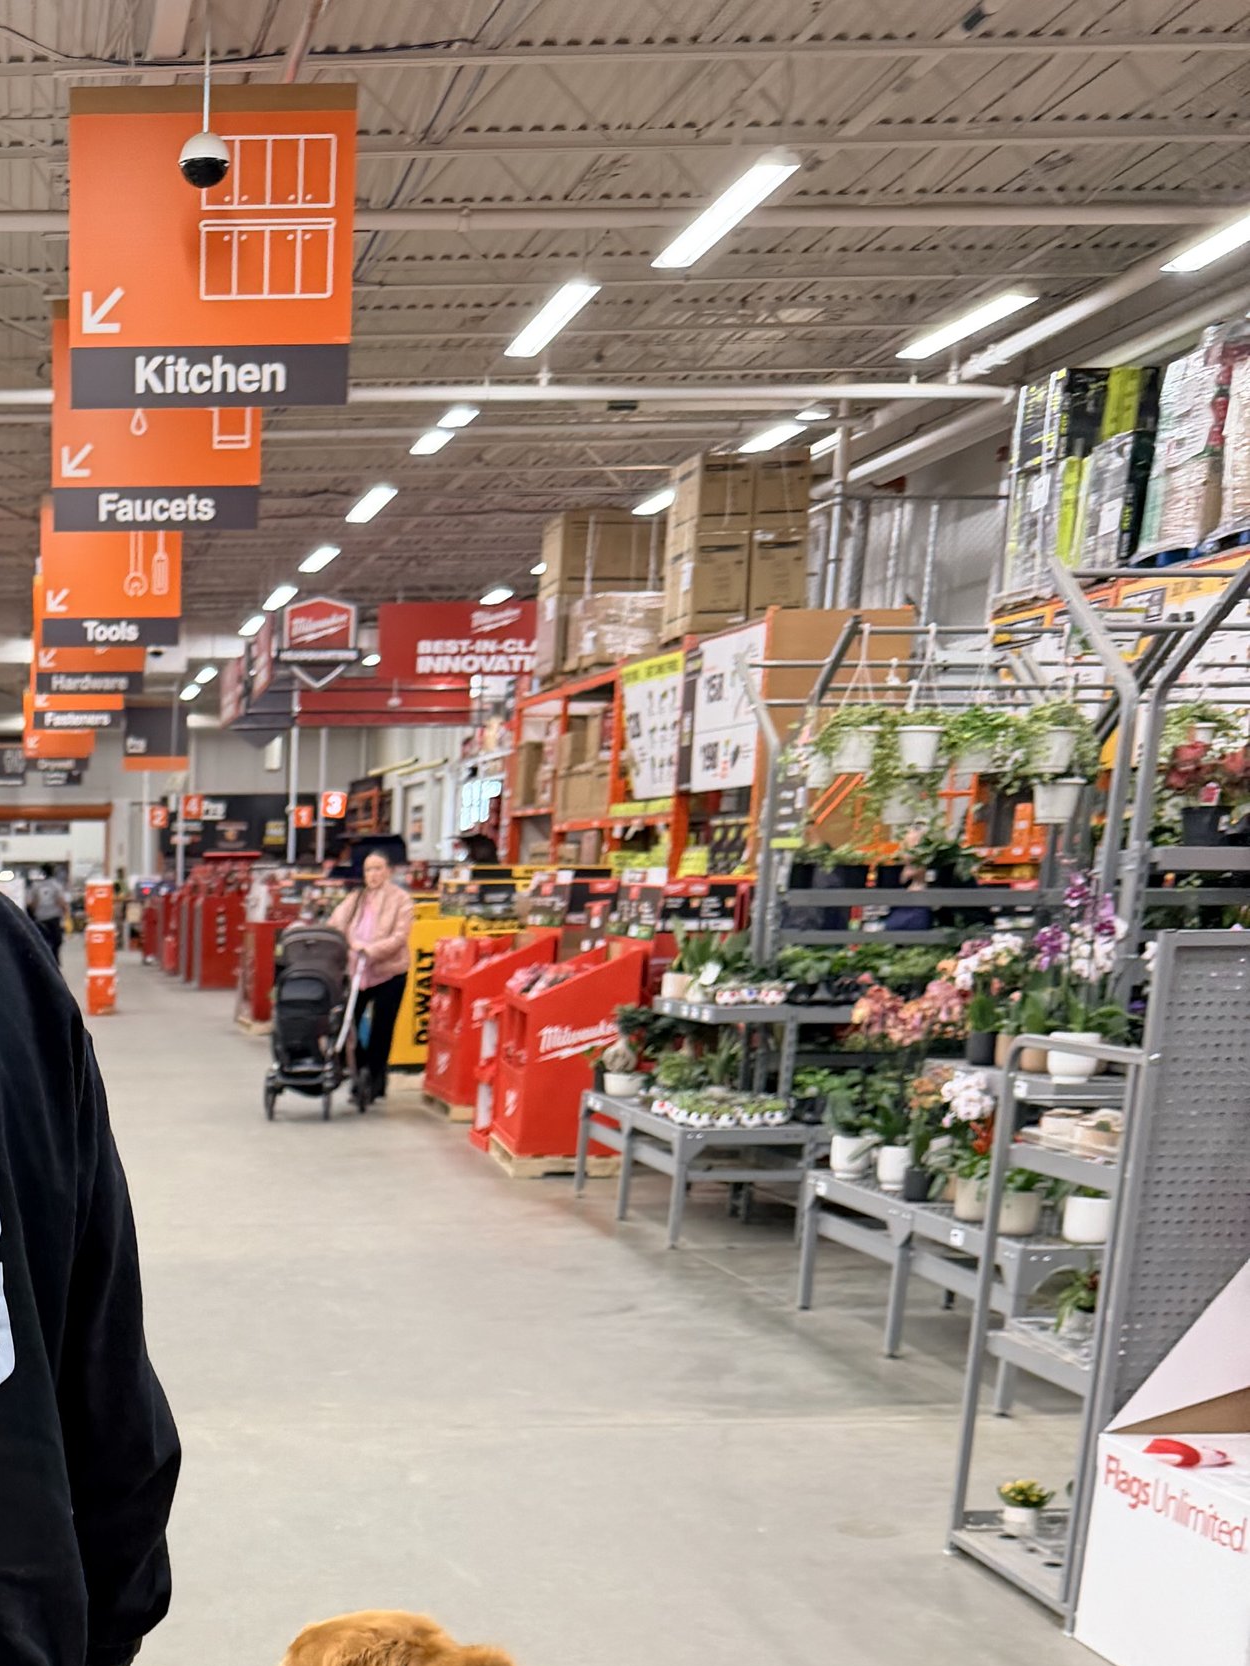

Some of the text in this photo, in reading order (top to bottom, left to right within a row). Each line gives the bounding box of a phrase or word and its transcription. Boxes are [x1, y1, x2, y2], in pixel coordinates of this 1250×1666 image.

[134, 354, 287, 394] Kitchen
[98, 493, 216, 522] Faucets
[82, 620, 140, 642] Tools
[51, 675, 129, 691] Hardware
[44, 711, 111, 727] Fasteners
